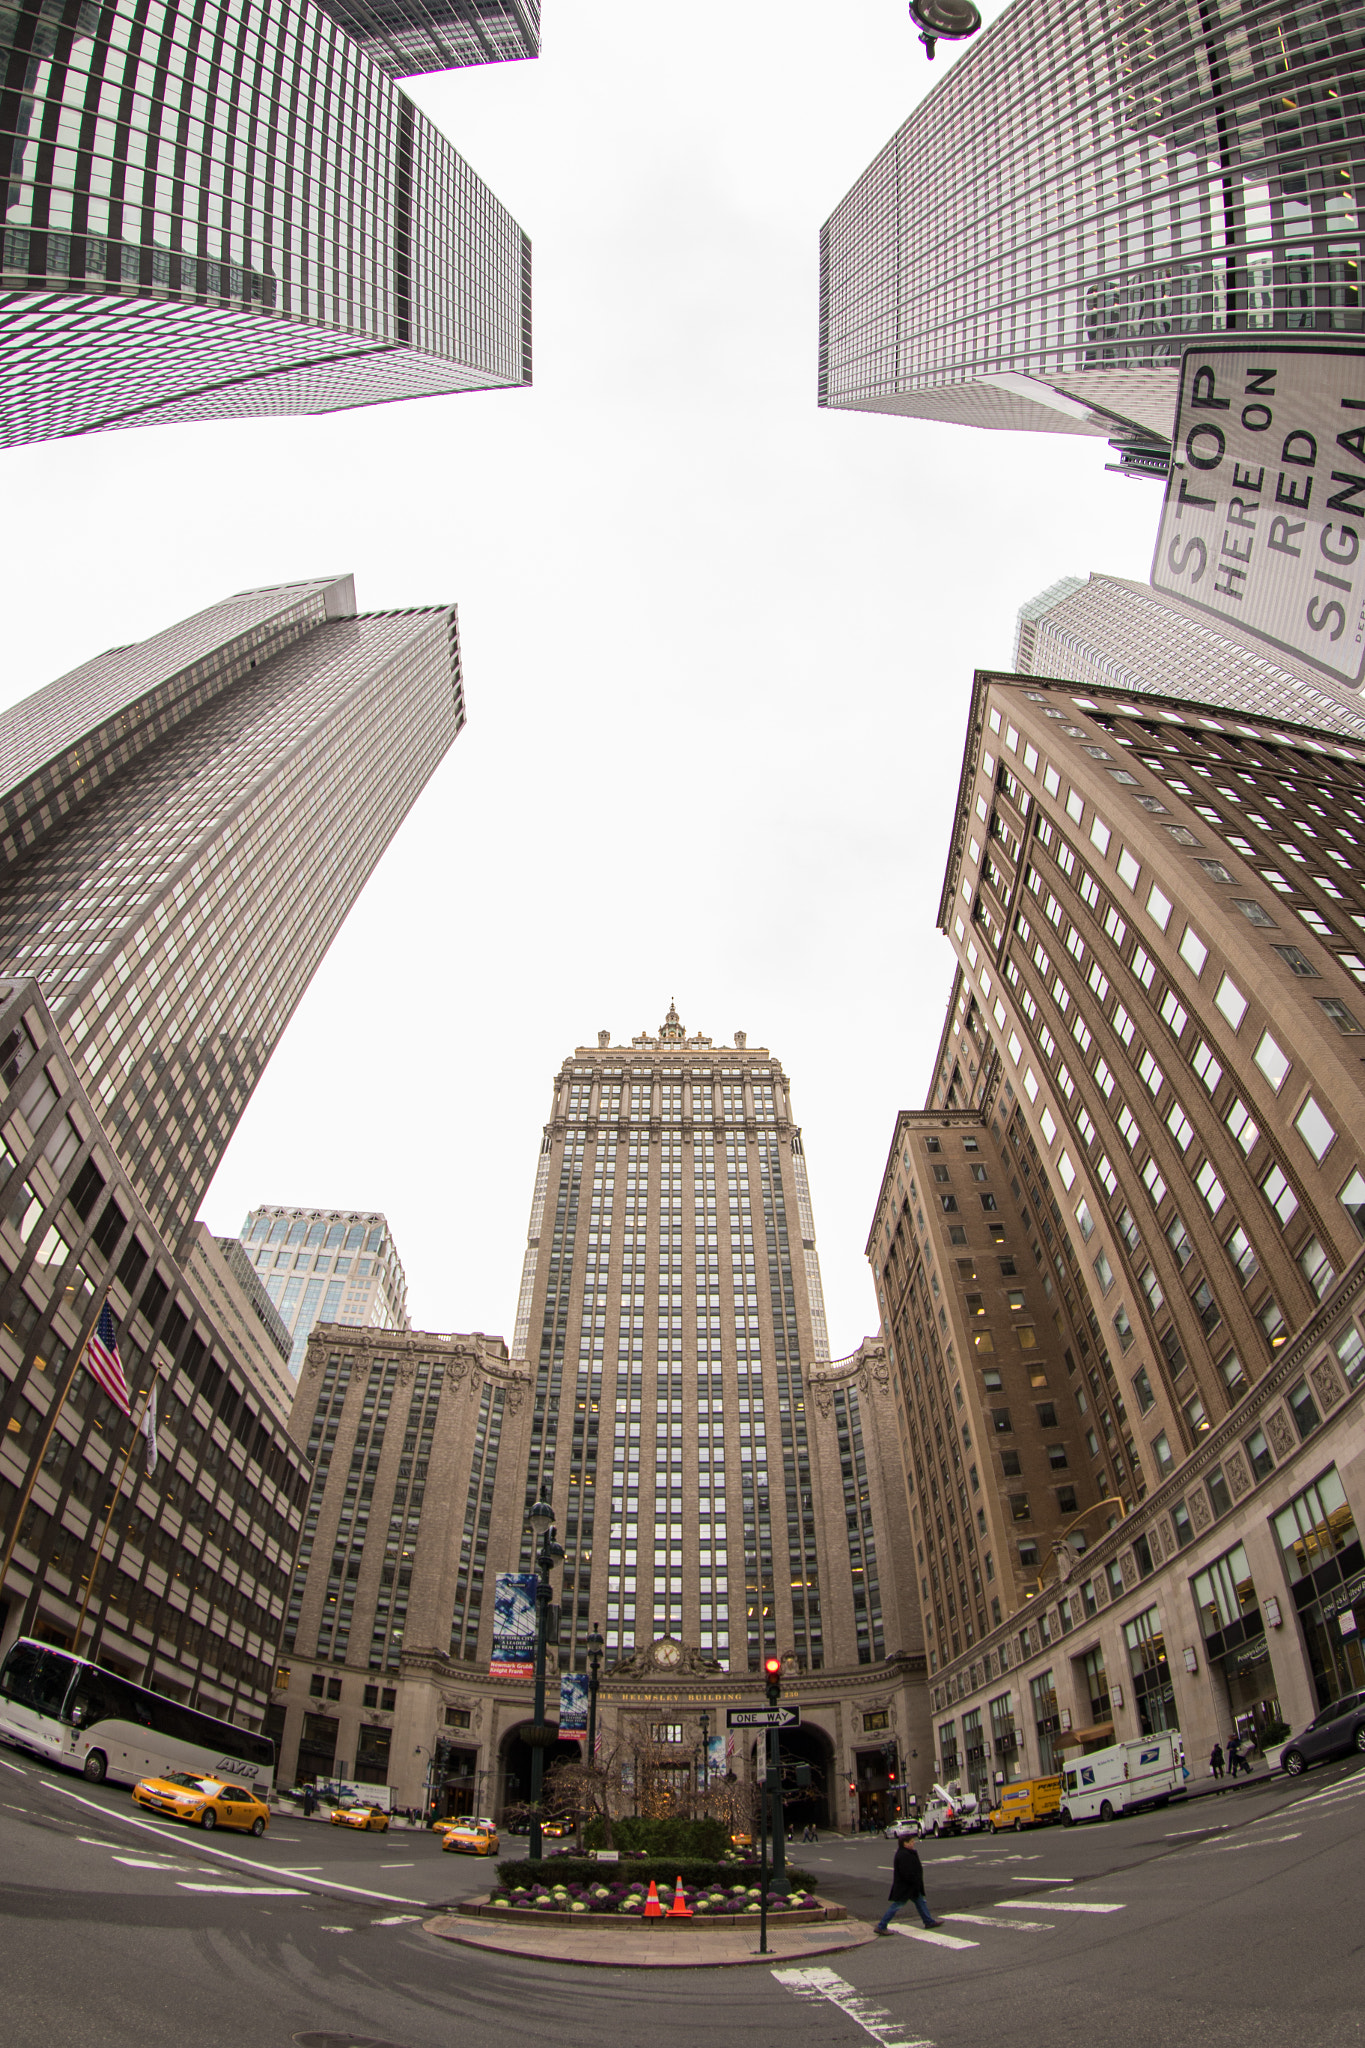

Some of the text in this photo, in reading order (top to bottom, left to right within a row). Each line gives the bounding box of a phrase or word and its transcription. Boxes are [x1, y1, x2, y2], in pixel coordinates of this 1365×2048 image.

[1168, 365, 1231, 584] STOP
[1214, 368, 1277, 601] HERE ON
[1267, 429, 1317, 558] RED
[688, 1693, 742, 1701] BUILDING
[736, 1712, 788, 1723] ONE WAY
